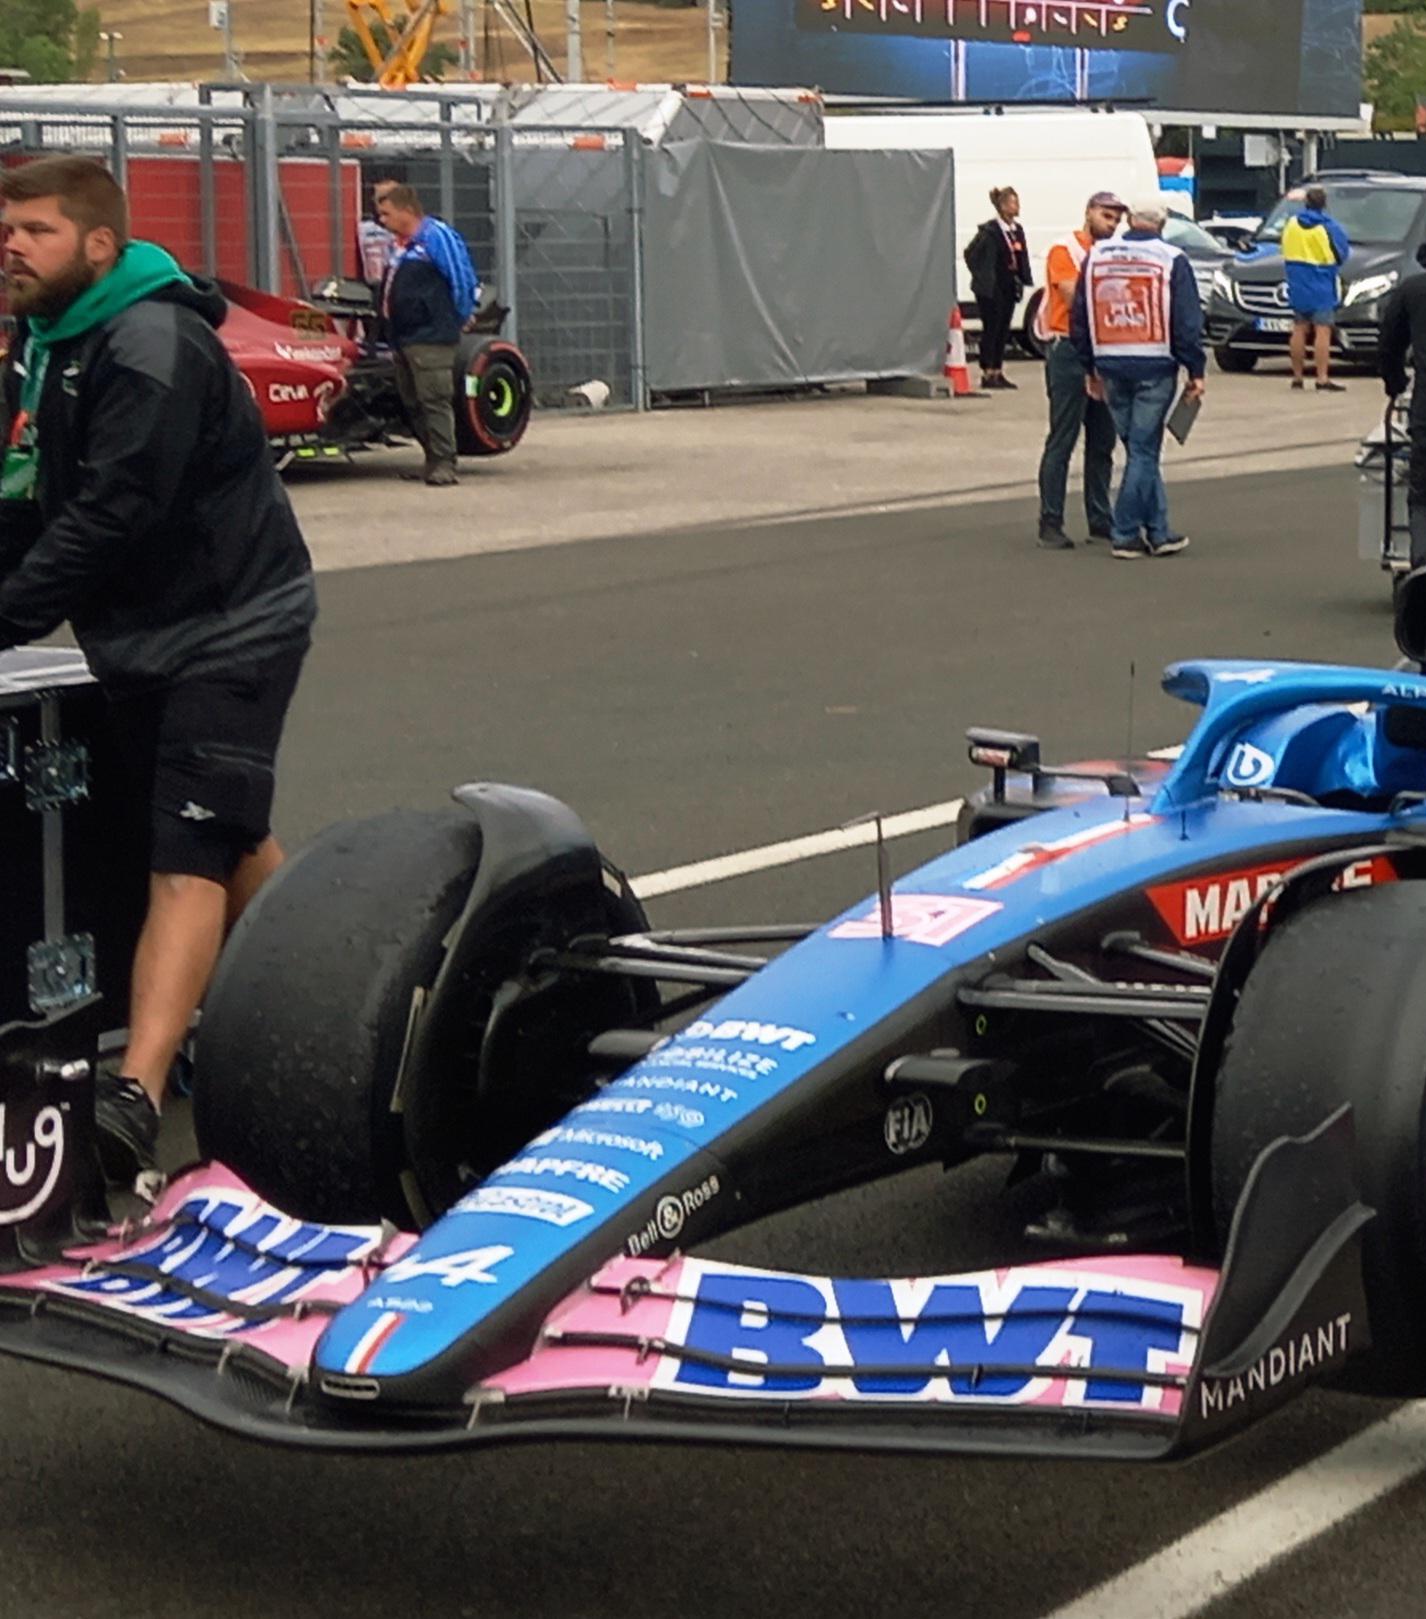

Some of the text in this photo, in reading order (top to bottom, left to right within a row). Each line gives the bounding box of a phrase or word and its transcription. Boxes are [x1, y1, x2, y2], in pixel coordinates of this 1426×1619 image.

[1183, 858, 1374, 940] MAPE
[885, 1094, 932, 1155] FIA
[627, 1224, 659, 1257] Bell
[682, 1174, 720, 1217] Ross
[672, 1272, 1185, 1404] BWT
[1201, 1315, 1352, 1418] MANDIANT
